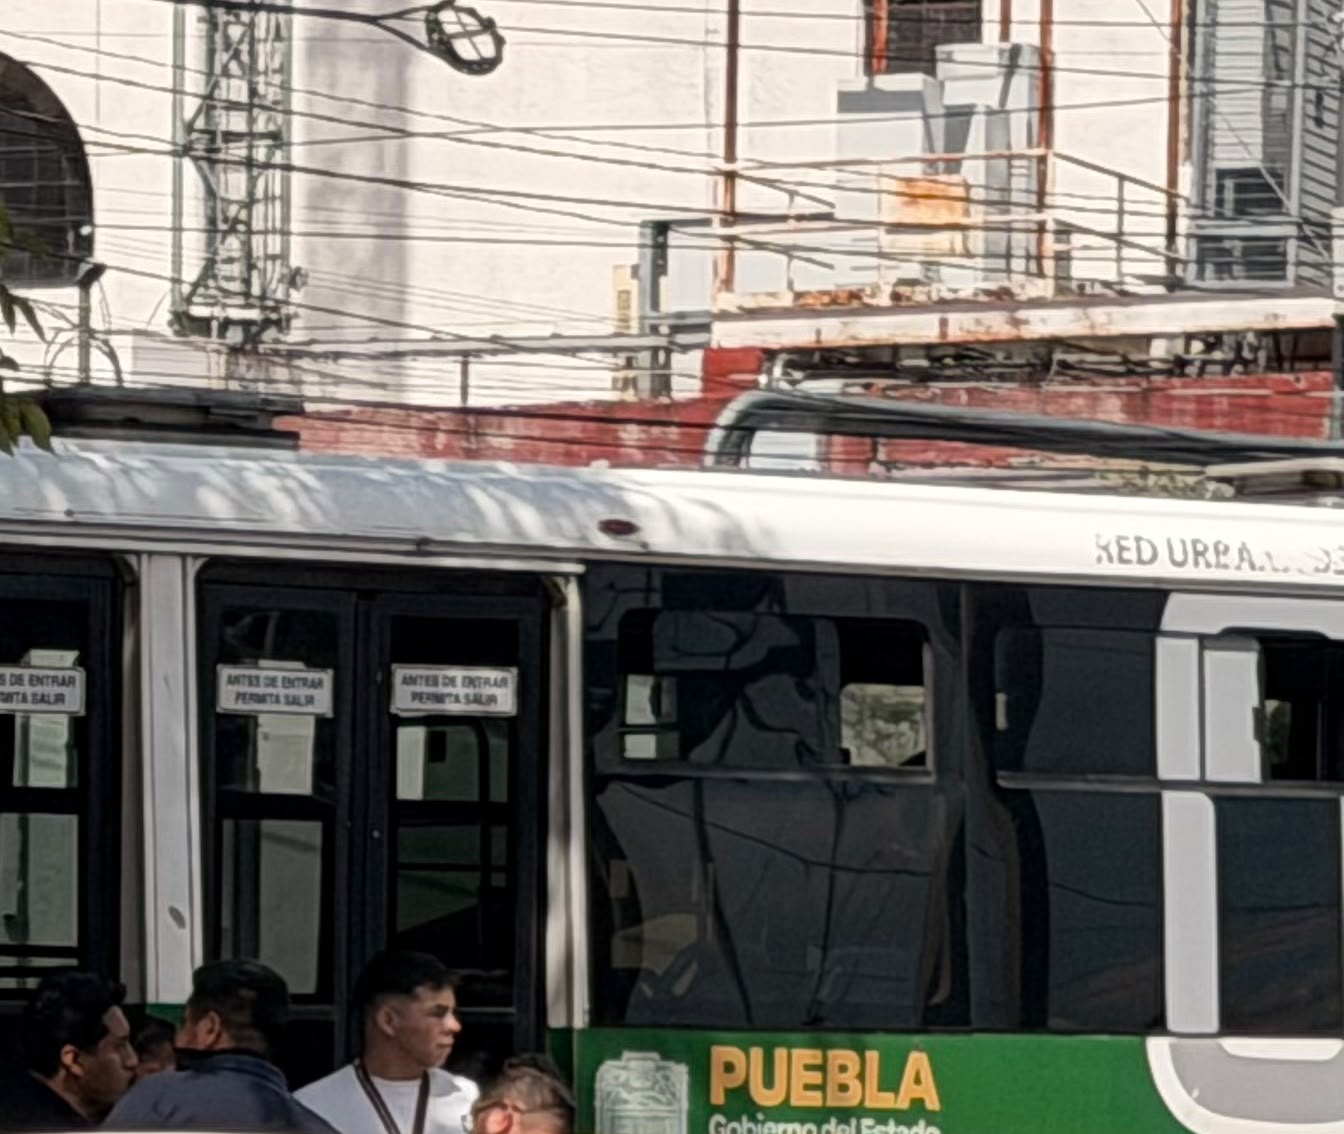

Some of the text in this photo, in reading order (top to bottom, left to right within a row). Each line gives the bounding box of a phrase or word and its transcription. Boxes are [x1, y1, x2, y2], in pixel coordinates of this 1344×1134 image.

[1095, 533, 1159, 566] RED
[9, 673, 25, 687] DE
[28, 674, 76, 689] ENTRAR
[226, 674, 324, 690] ANTES DE ENTRAR
[401, 674, 508, 689] ANTES DE ENTRAR
[31, 691, 65, 706] SALIR
[234, 692, 315, 706] PERMITA SALIR
[411, 691, 498, 706] PERMITA SALIR
[710, 1045, 941, 1111] PUEBLA
